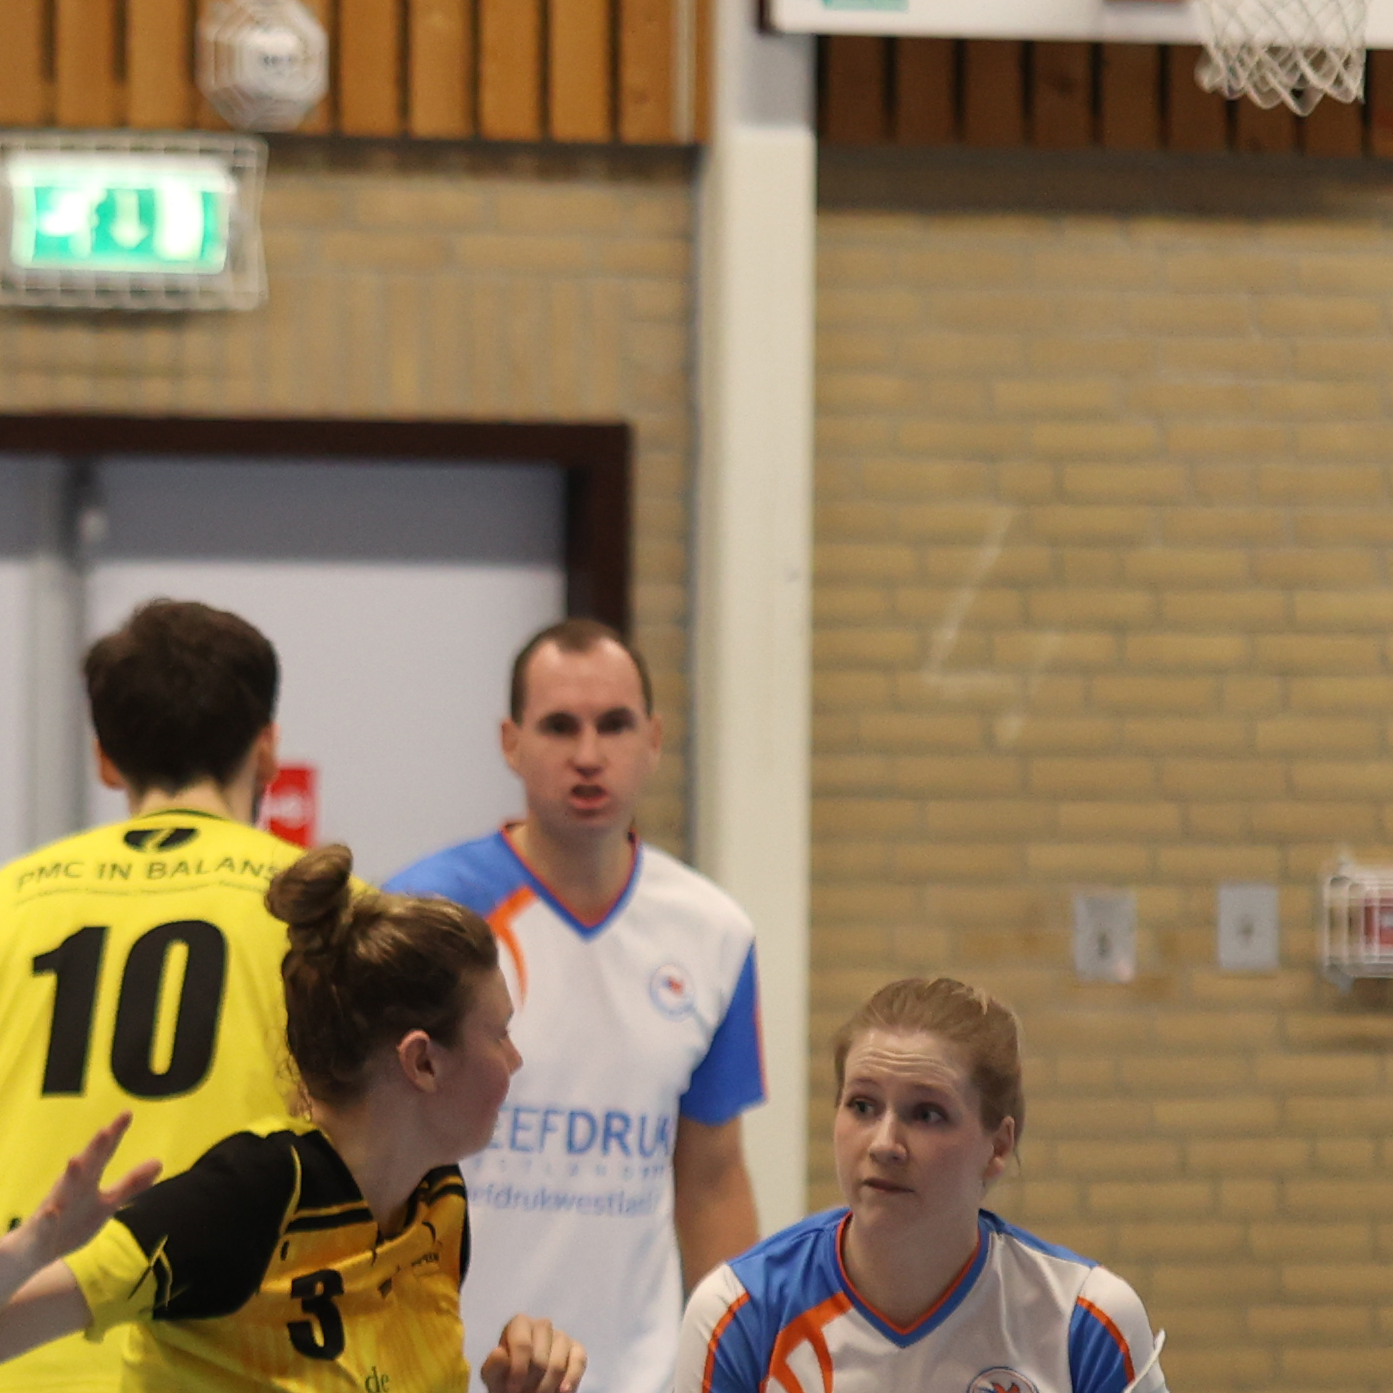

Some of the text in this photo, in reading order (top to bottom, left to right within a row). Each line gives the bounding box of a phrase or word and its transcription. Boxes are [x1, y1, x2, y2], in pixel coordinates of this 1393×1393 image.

[17, 860, 85, 891] PMC
[97, 862, 133, 880] IN
[32, 919, 228, 1101] 10
[287, 1268, 345, 1361] 3
